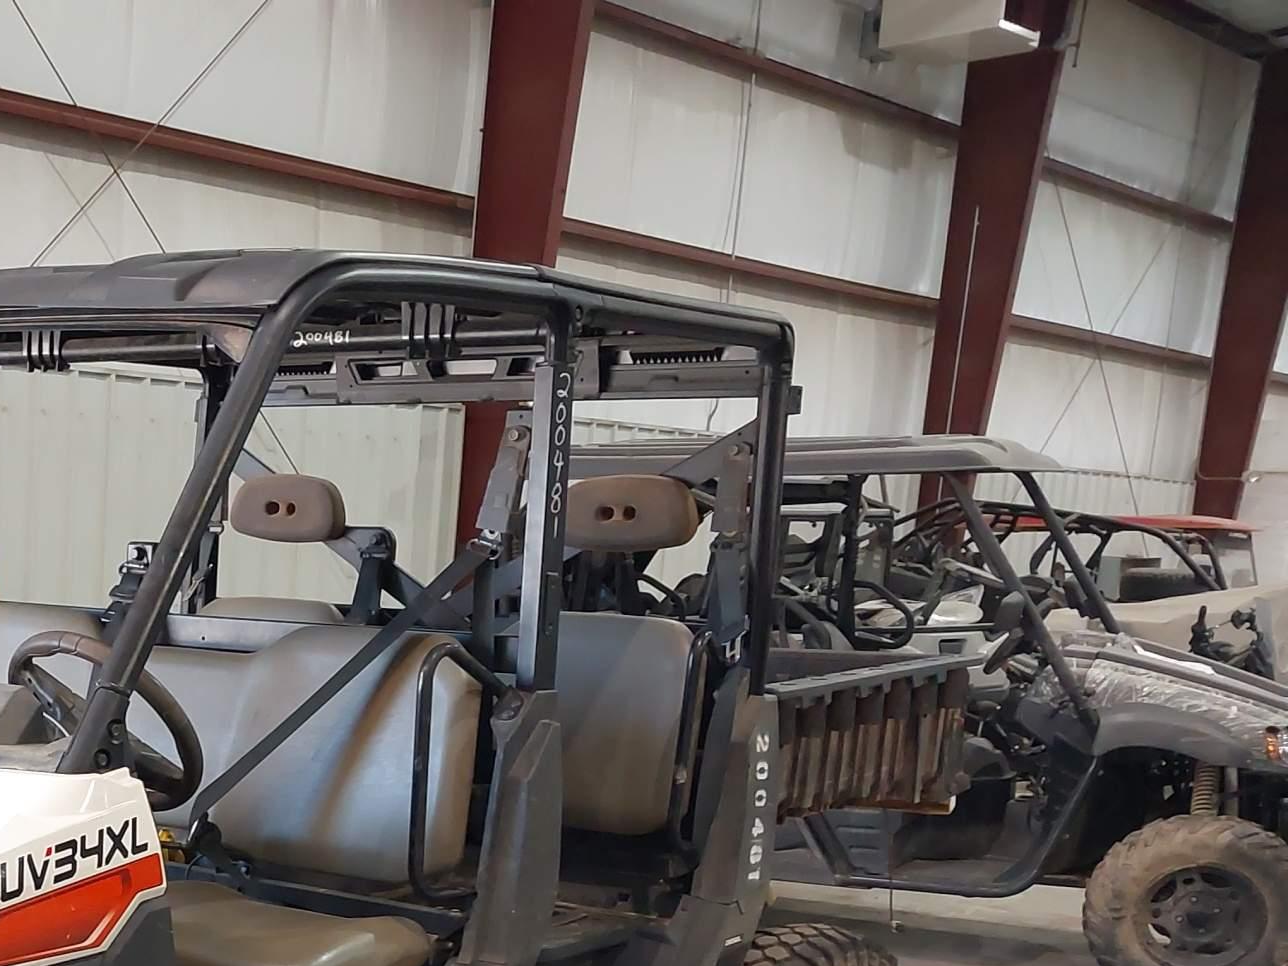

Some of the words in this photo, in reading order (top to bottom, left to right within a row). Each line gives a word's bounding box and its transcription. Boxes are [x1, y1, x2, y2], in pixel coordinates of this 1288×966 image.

[293, 330, 350, 348] 200481
[550, 373, 572, 539] 200481
[0, 817, 149, 902] UV34XL
